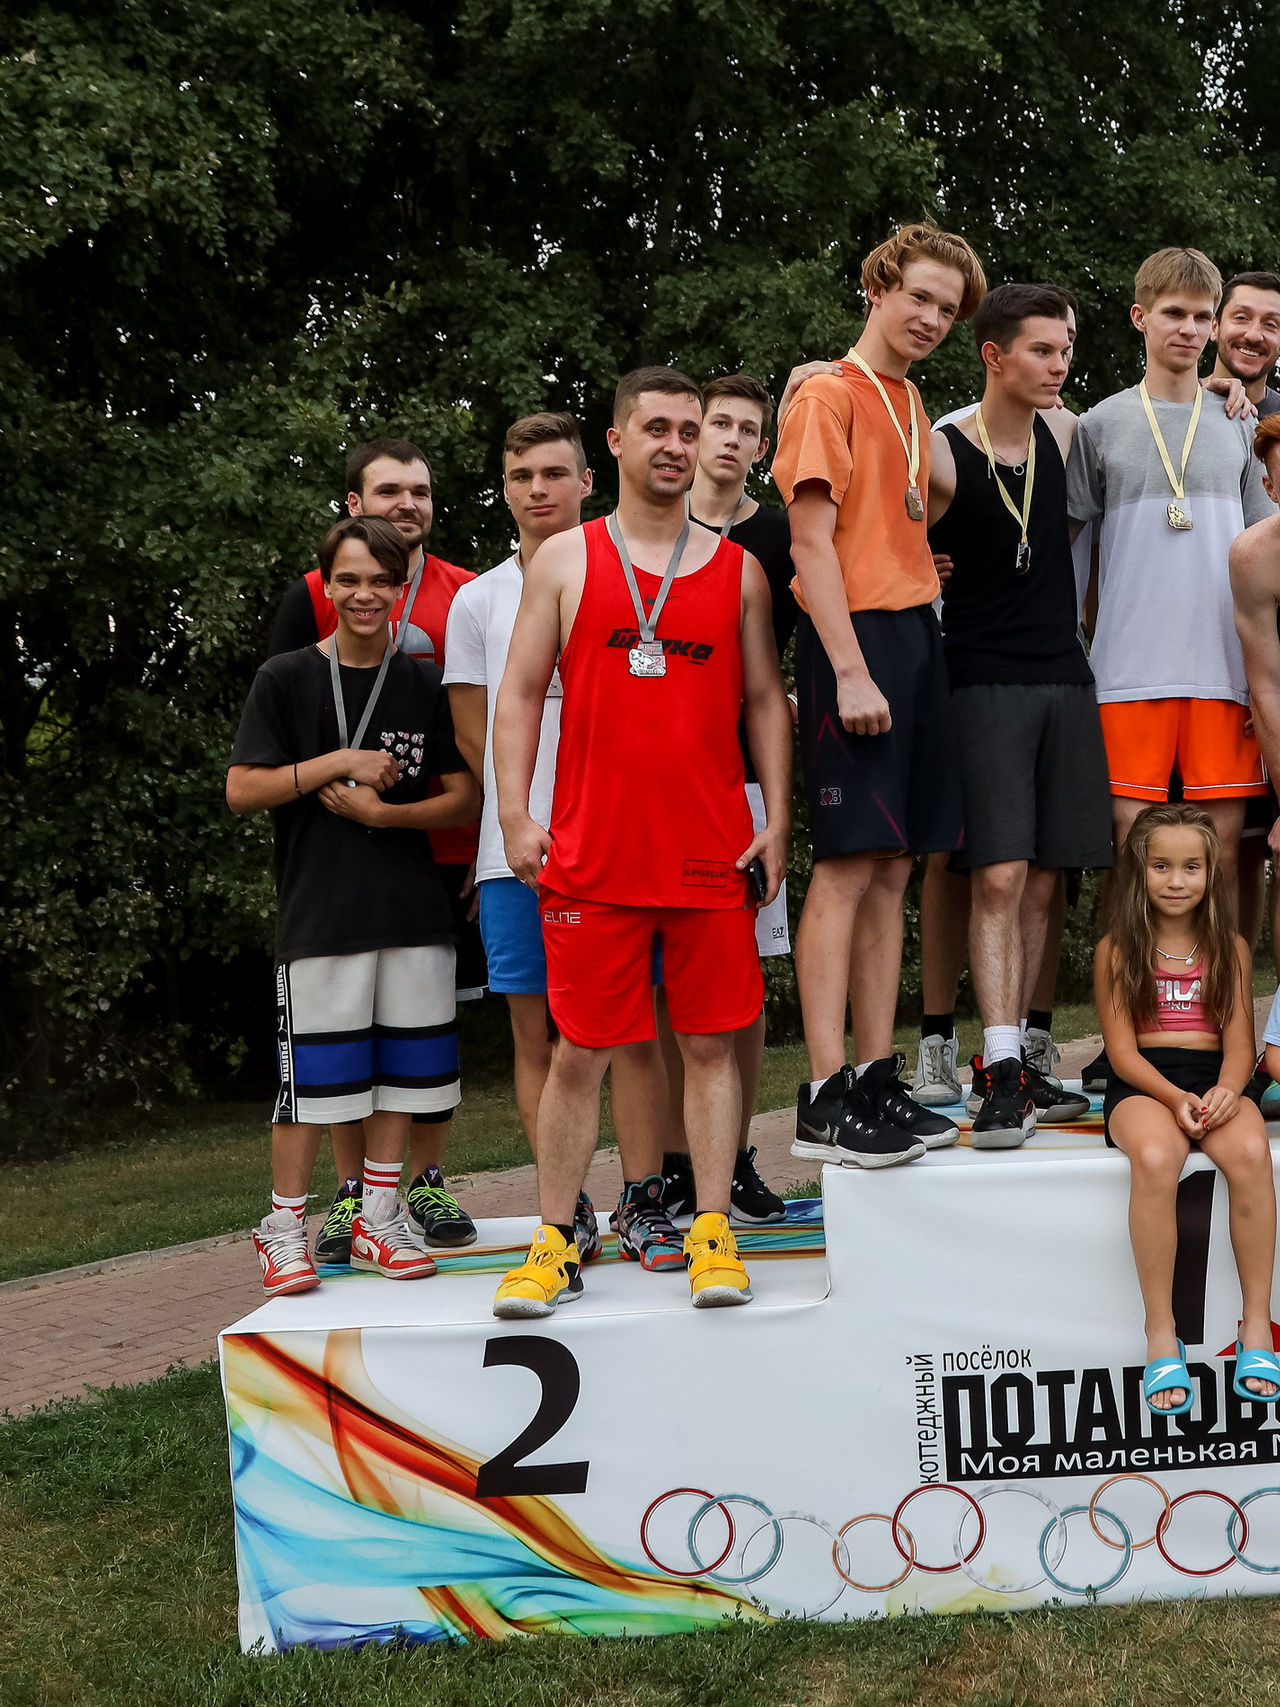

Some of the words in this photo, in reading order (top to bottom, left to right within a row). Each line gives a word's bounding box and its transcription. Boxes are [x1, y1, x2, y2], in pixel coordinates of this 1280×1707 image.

[544, 910, 582, 924] ELITE
[1155, 979, 1202, 1002] FILA
[943, 1344, 1032, 1372] посёлок
[475, 1334, 590, 1498] 2
[906, 1354, 943, 1484] коттеджный
[960, 1451, 1041, 1475] Моя
[1054, 1440, 1257, 1472] маленькая
